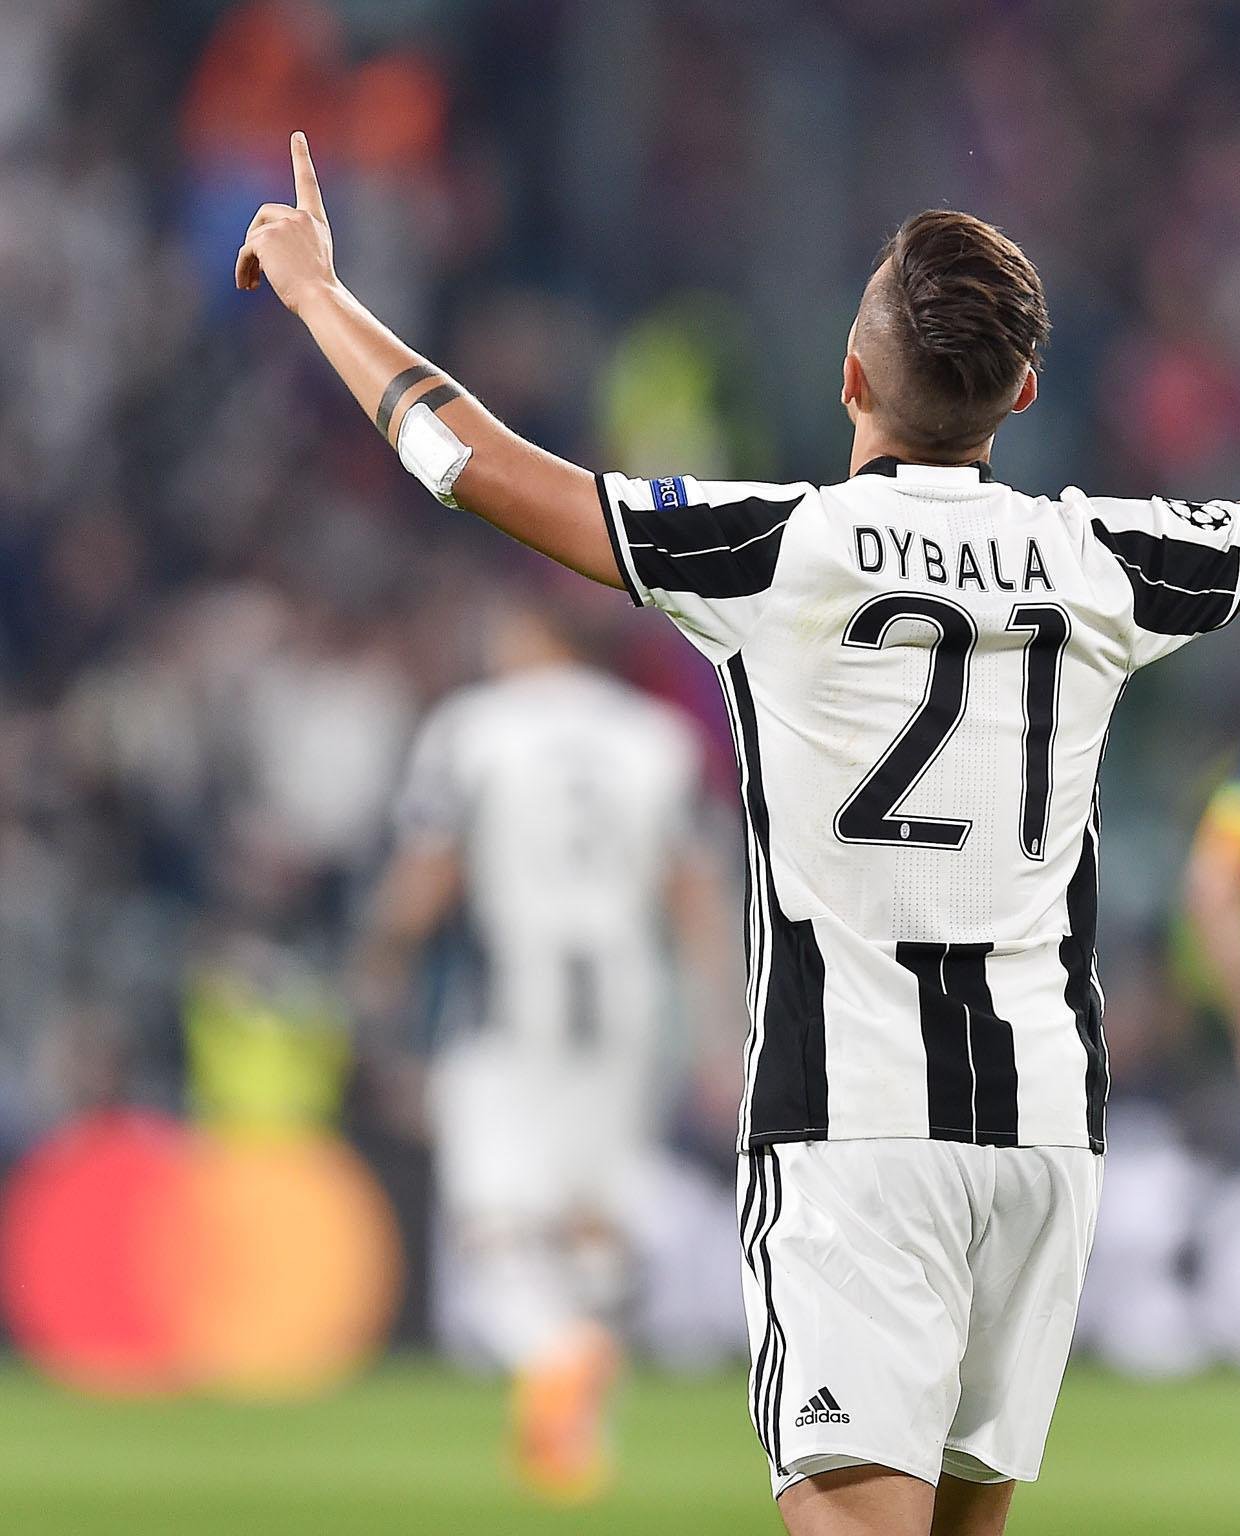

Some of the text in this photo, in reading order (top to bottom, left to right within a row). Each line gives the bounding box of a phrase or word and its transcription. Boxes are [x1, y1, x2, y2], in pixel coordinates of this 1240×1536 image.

[853, 525, 1056, 593] DYBALA
[833, 591, 1072, 862] 21
[794, 1410, 851, 1428] adidas
